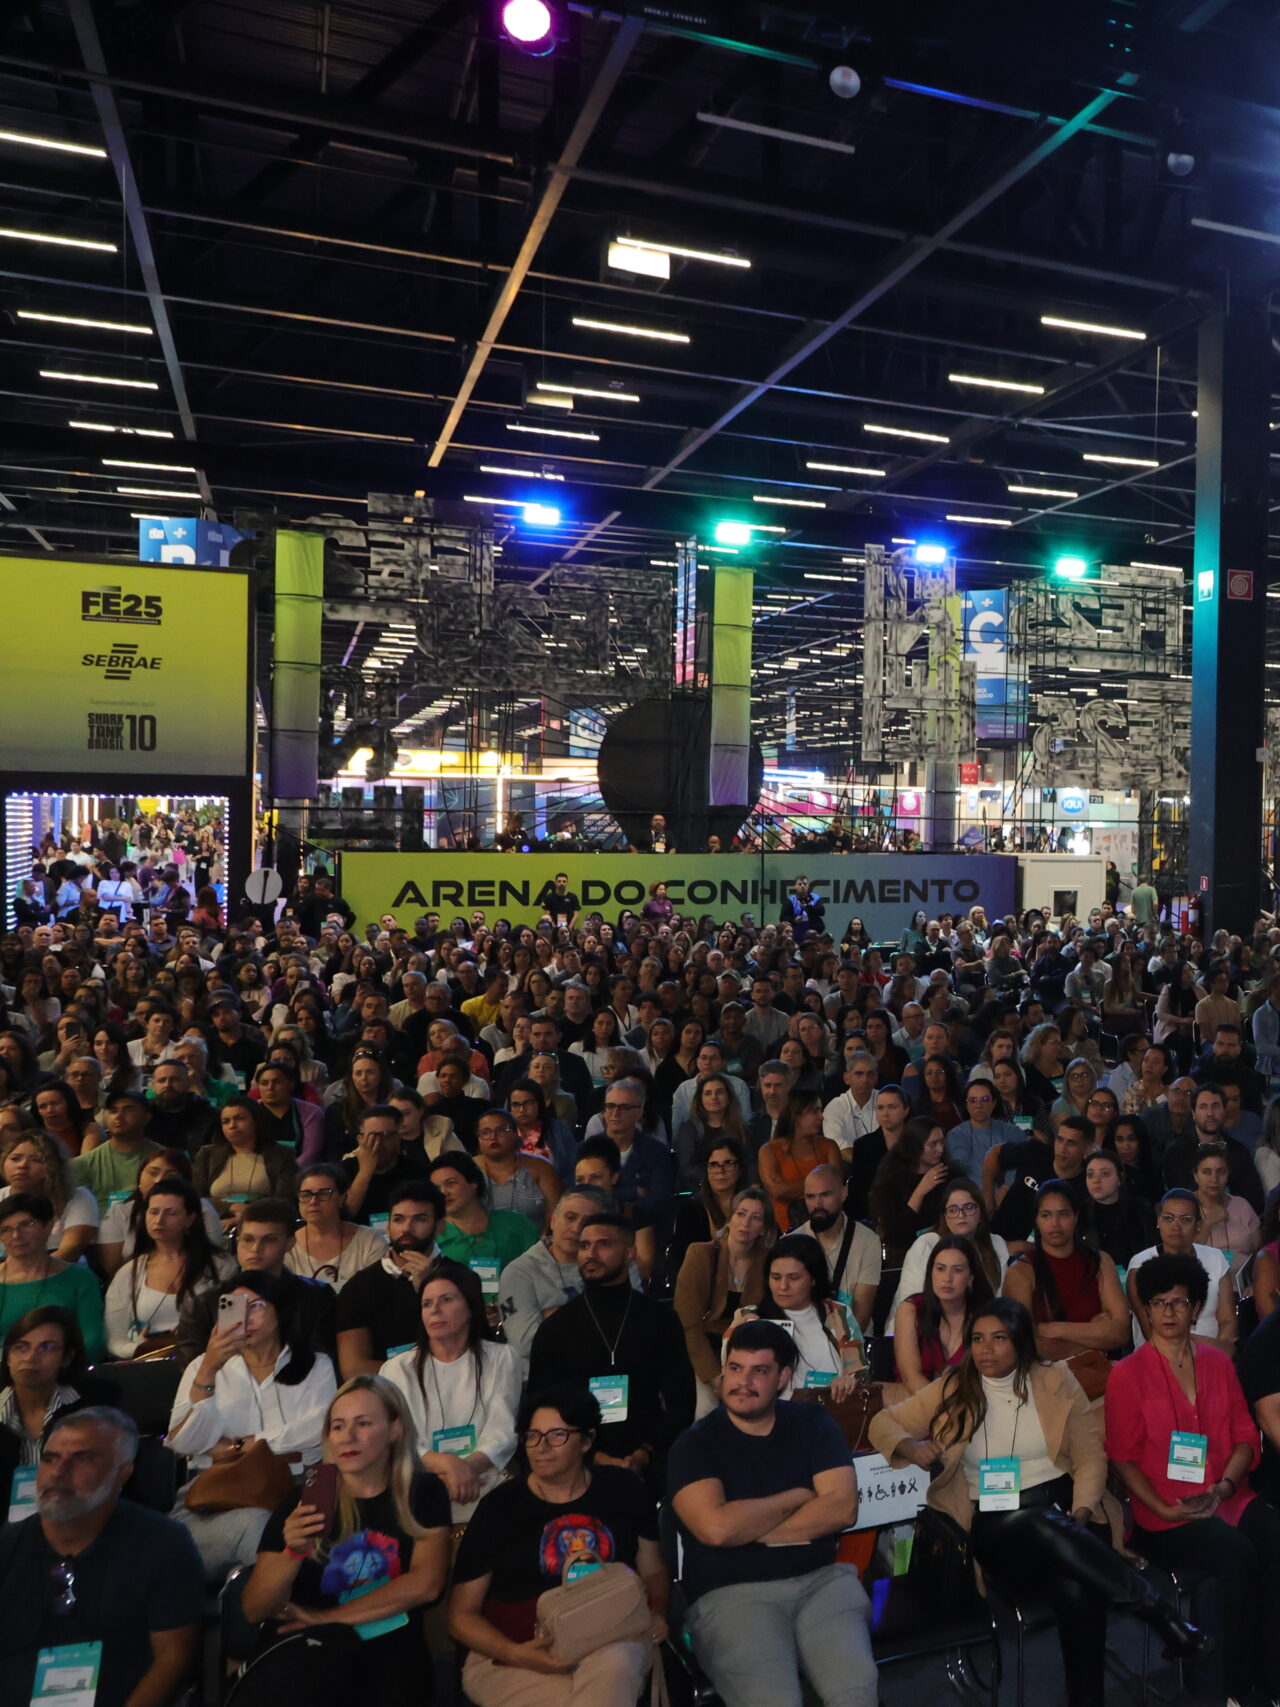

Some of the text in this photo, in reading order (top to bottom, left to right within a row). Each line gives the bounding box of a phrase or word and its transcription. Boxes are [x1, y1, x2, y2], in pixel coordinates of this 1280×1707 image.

[81, 587, 163, 618] FE25
[969, 610, 1005, 656] C
[81, 653, 163, 670] SEBRAE
[87, 712, 157, 752] SHARK 10
[87, 725, 124, 739] TANK
[581, 880, 646, 907] DO
